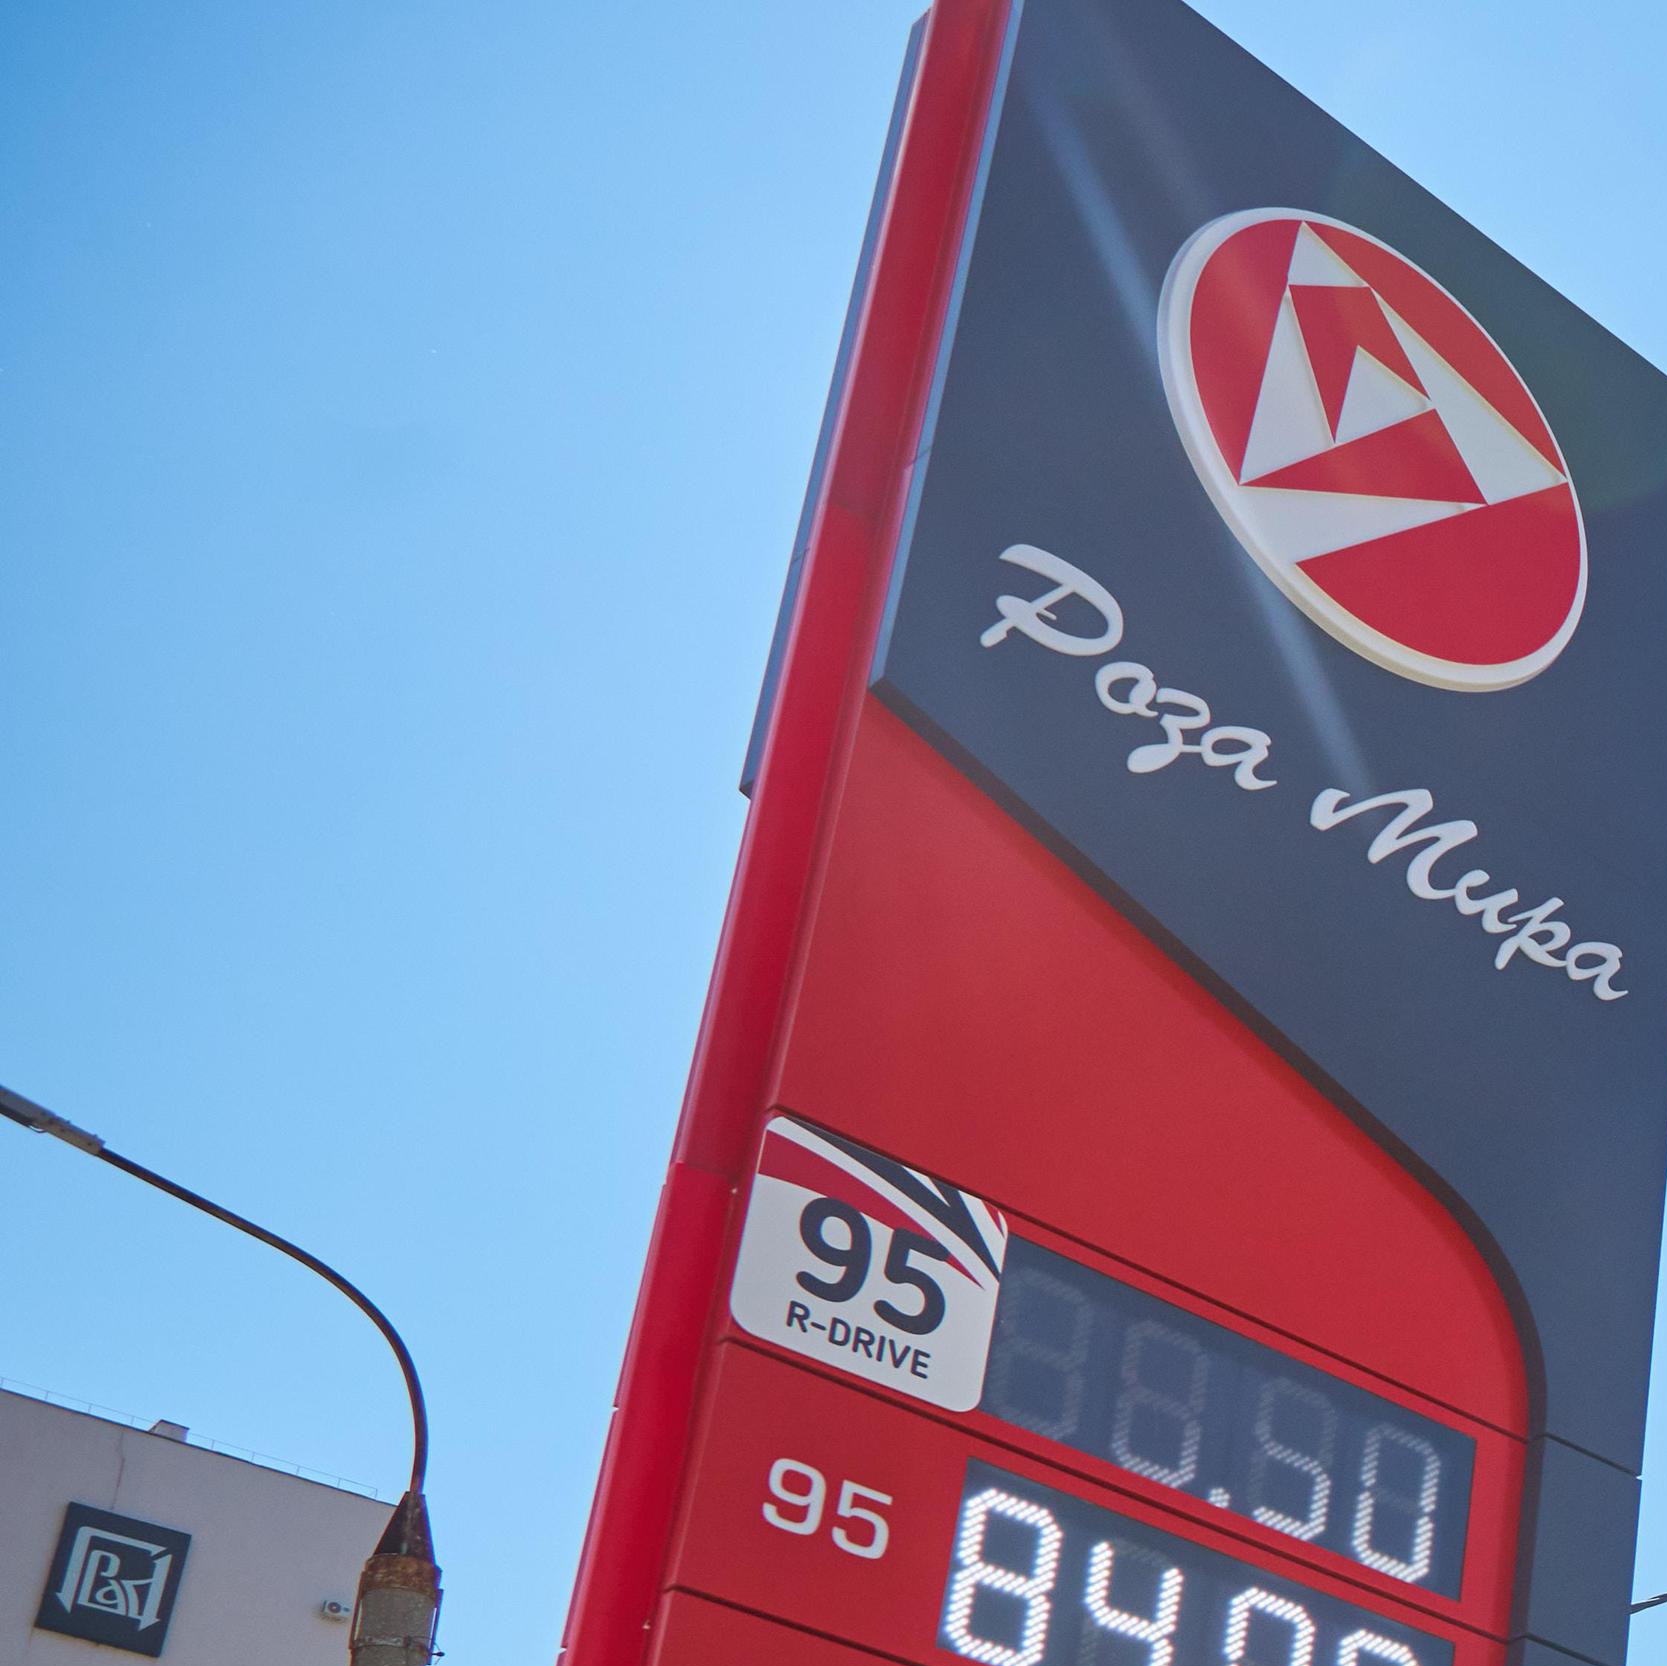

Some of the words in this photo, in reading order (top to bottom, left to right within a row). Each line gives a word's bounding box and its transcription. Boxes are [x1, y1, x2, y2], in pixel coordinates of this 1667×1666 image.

[980, 543, 1277, 788] Роза
[1310, 787, 1629, 1001] Мира
[797, 1198, 947, 1336] 95
[784, 1300, 932, 1381] R-DRIVE
[761, 1457, 896, 1561] 95
